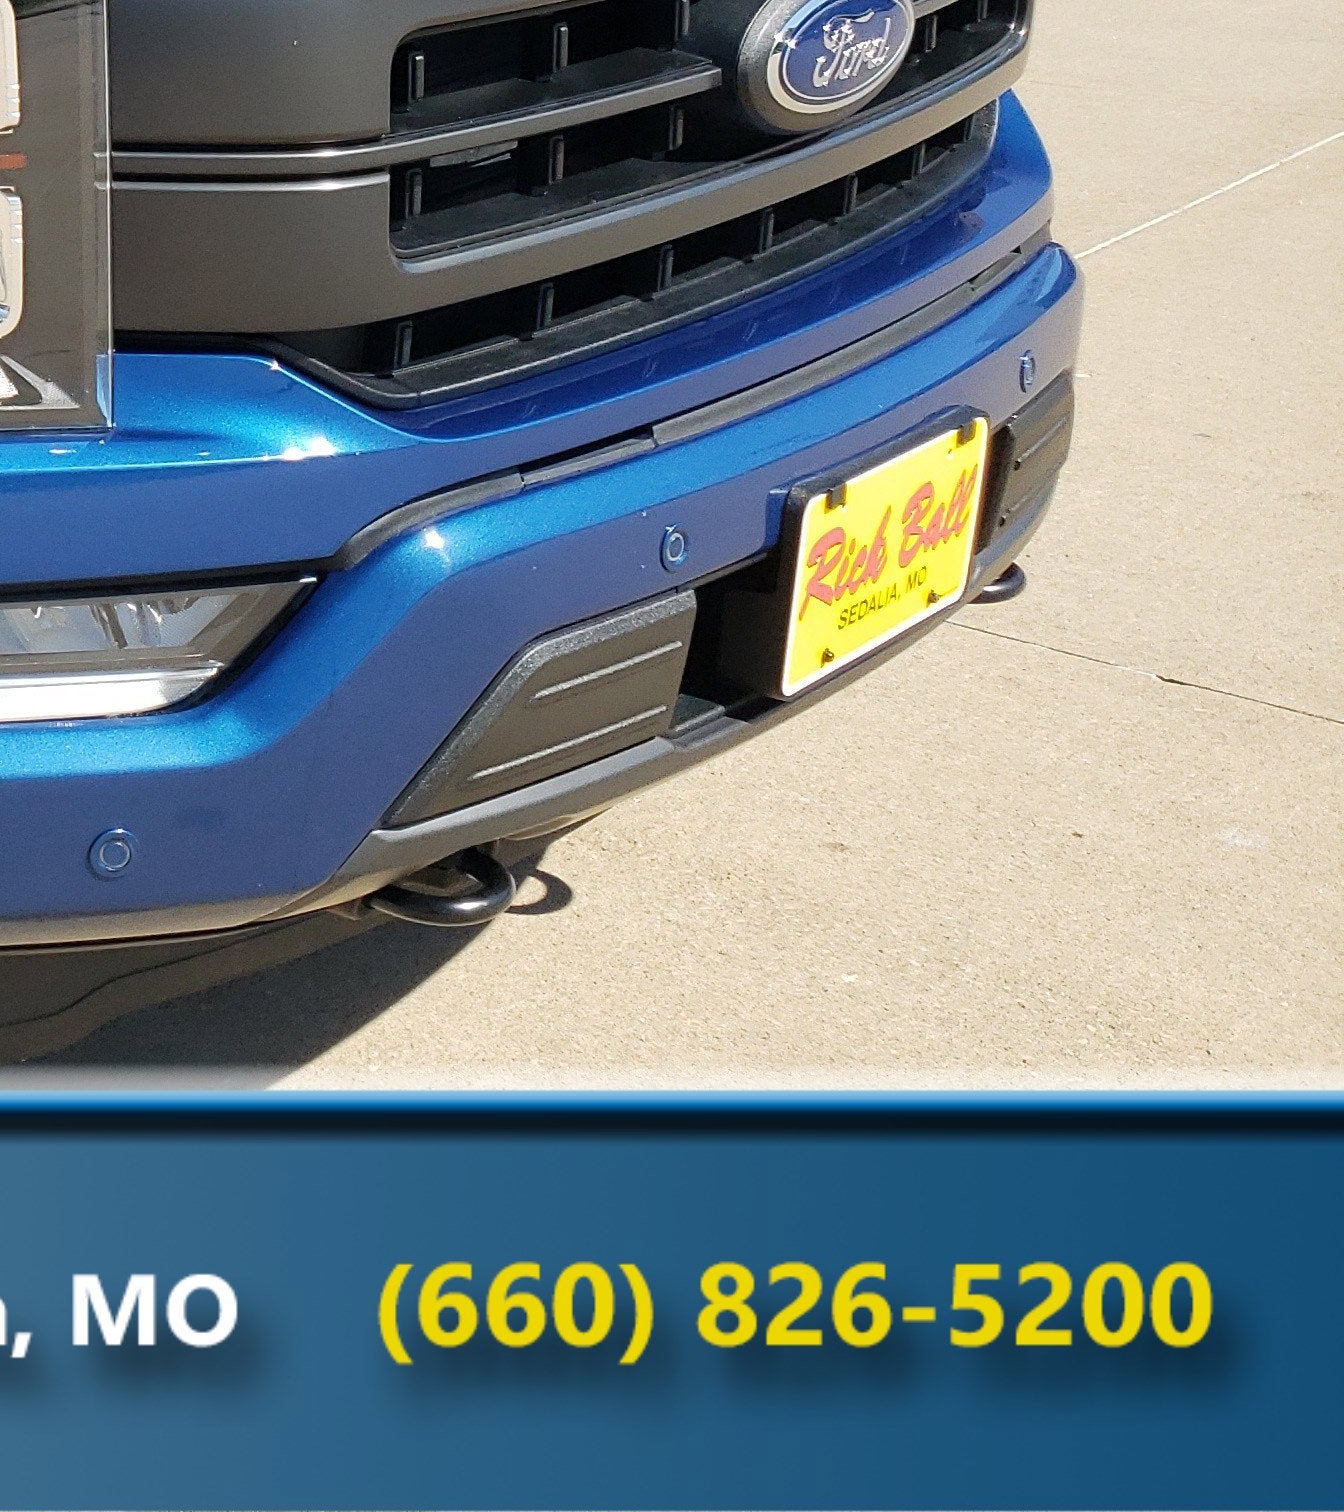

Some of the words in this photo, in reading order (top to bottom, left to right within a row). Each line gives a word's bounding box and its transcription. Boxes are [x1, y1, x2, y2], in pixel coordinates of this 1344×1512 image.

[812, 8, 892, 88] Ford
[799, 505, 892, 621] Rick
[898, 463, 979, 569] Ball
[837, 583, 901, 630] SEDALIA,
[906, 565, 928, 594] MO
